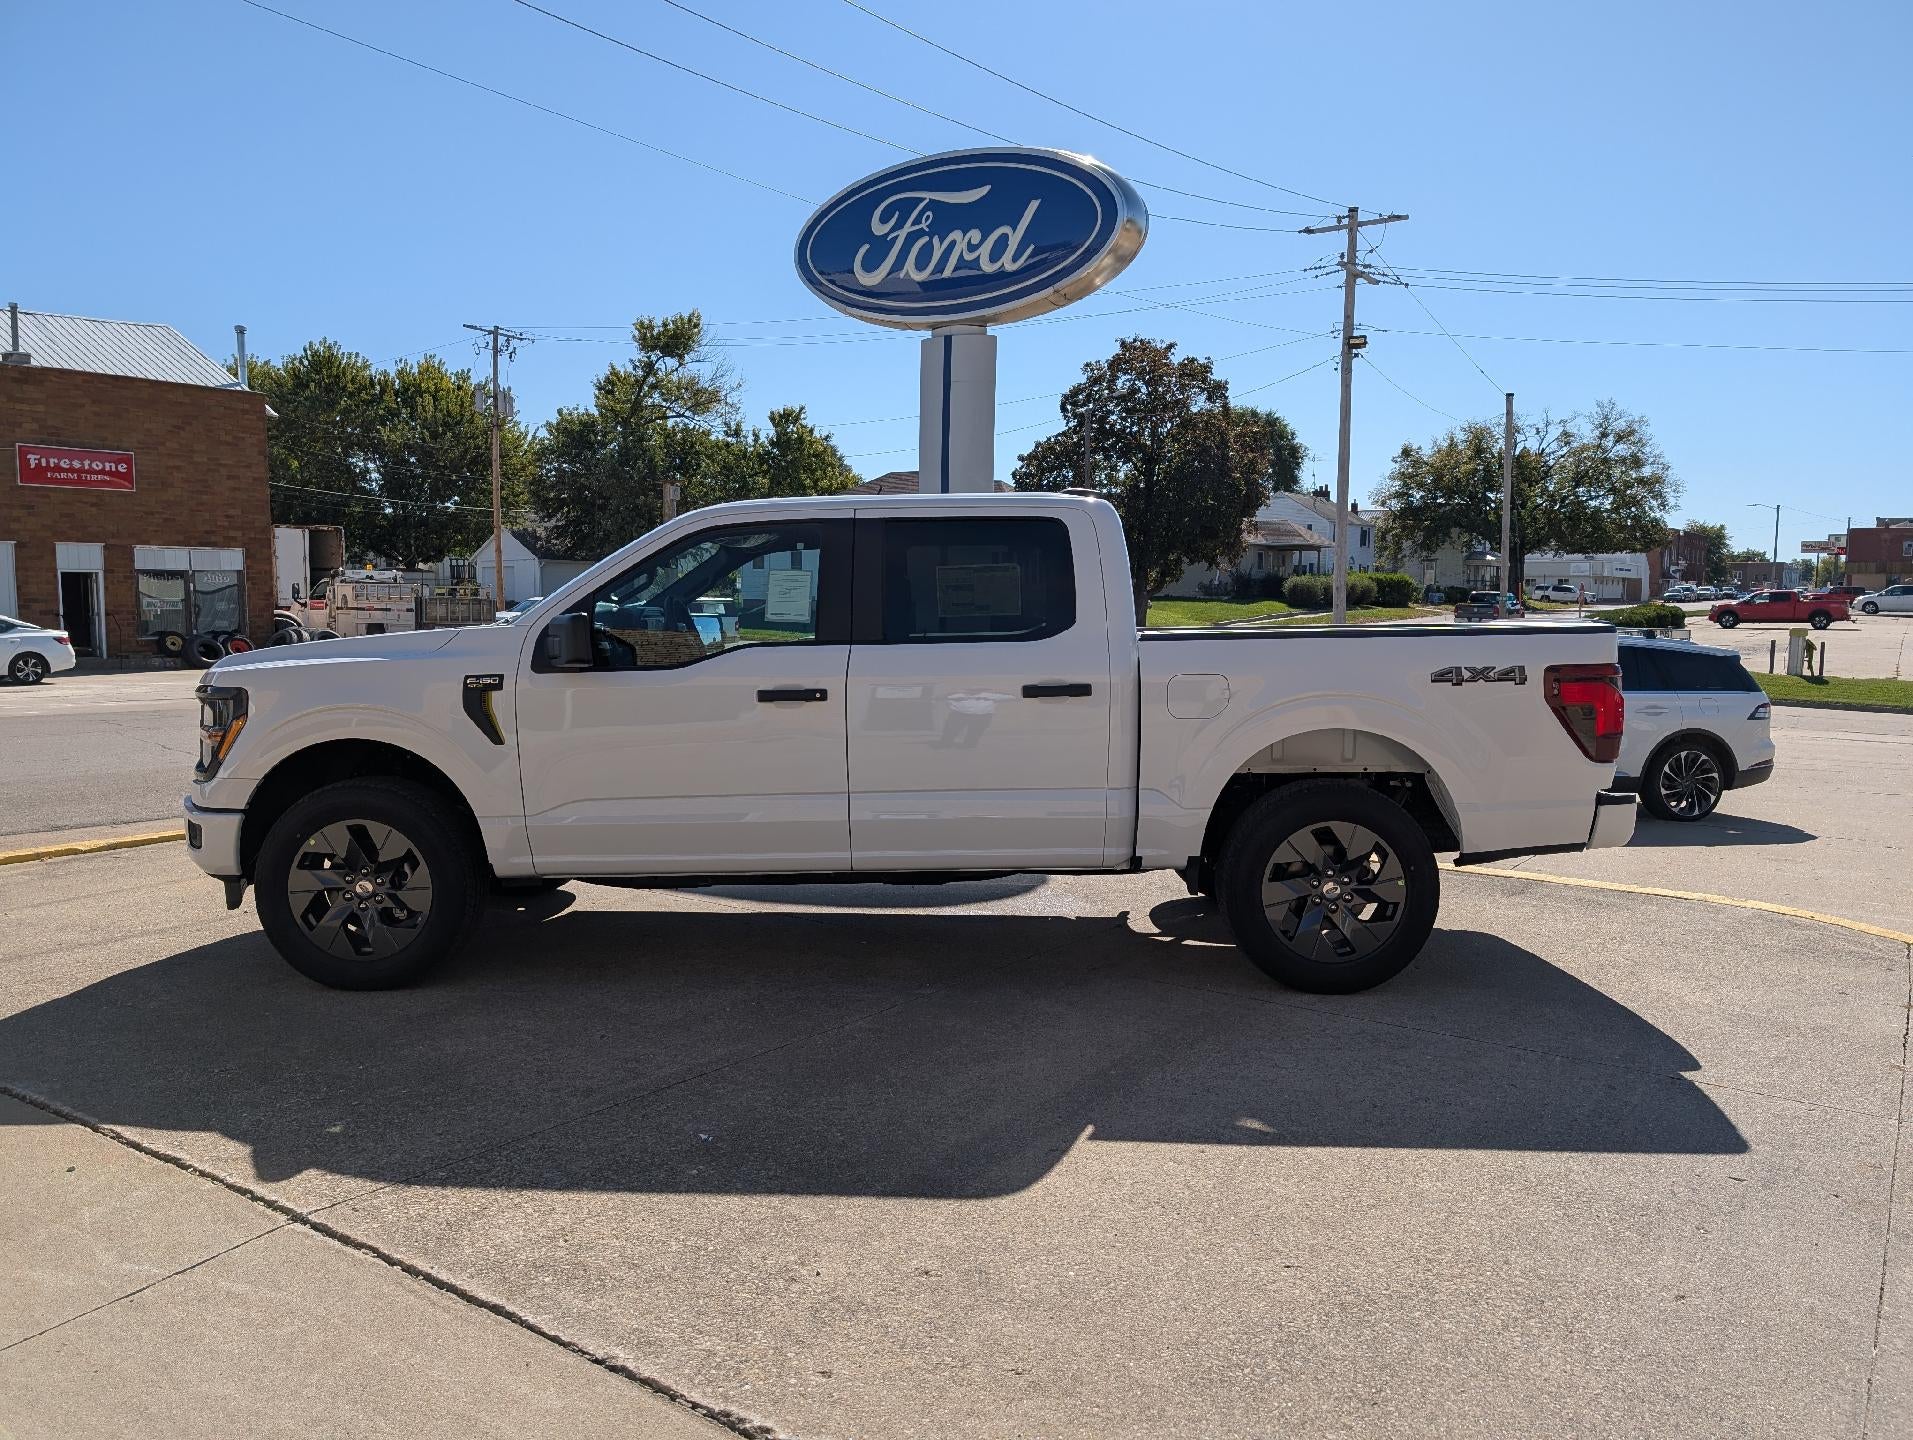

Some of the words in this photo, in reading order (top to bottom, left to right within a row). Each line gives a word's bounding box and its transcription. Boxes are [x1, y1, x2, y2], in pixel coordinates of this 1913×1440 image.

[853, 184, 1041, 286] Ford
[27, 454, 128, 472] Firestone
[80, 473, 110, 481] TIRES
